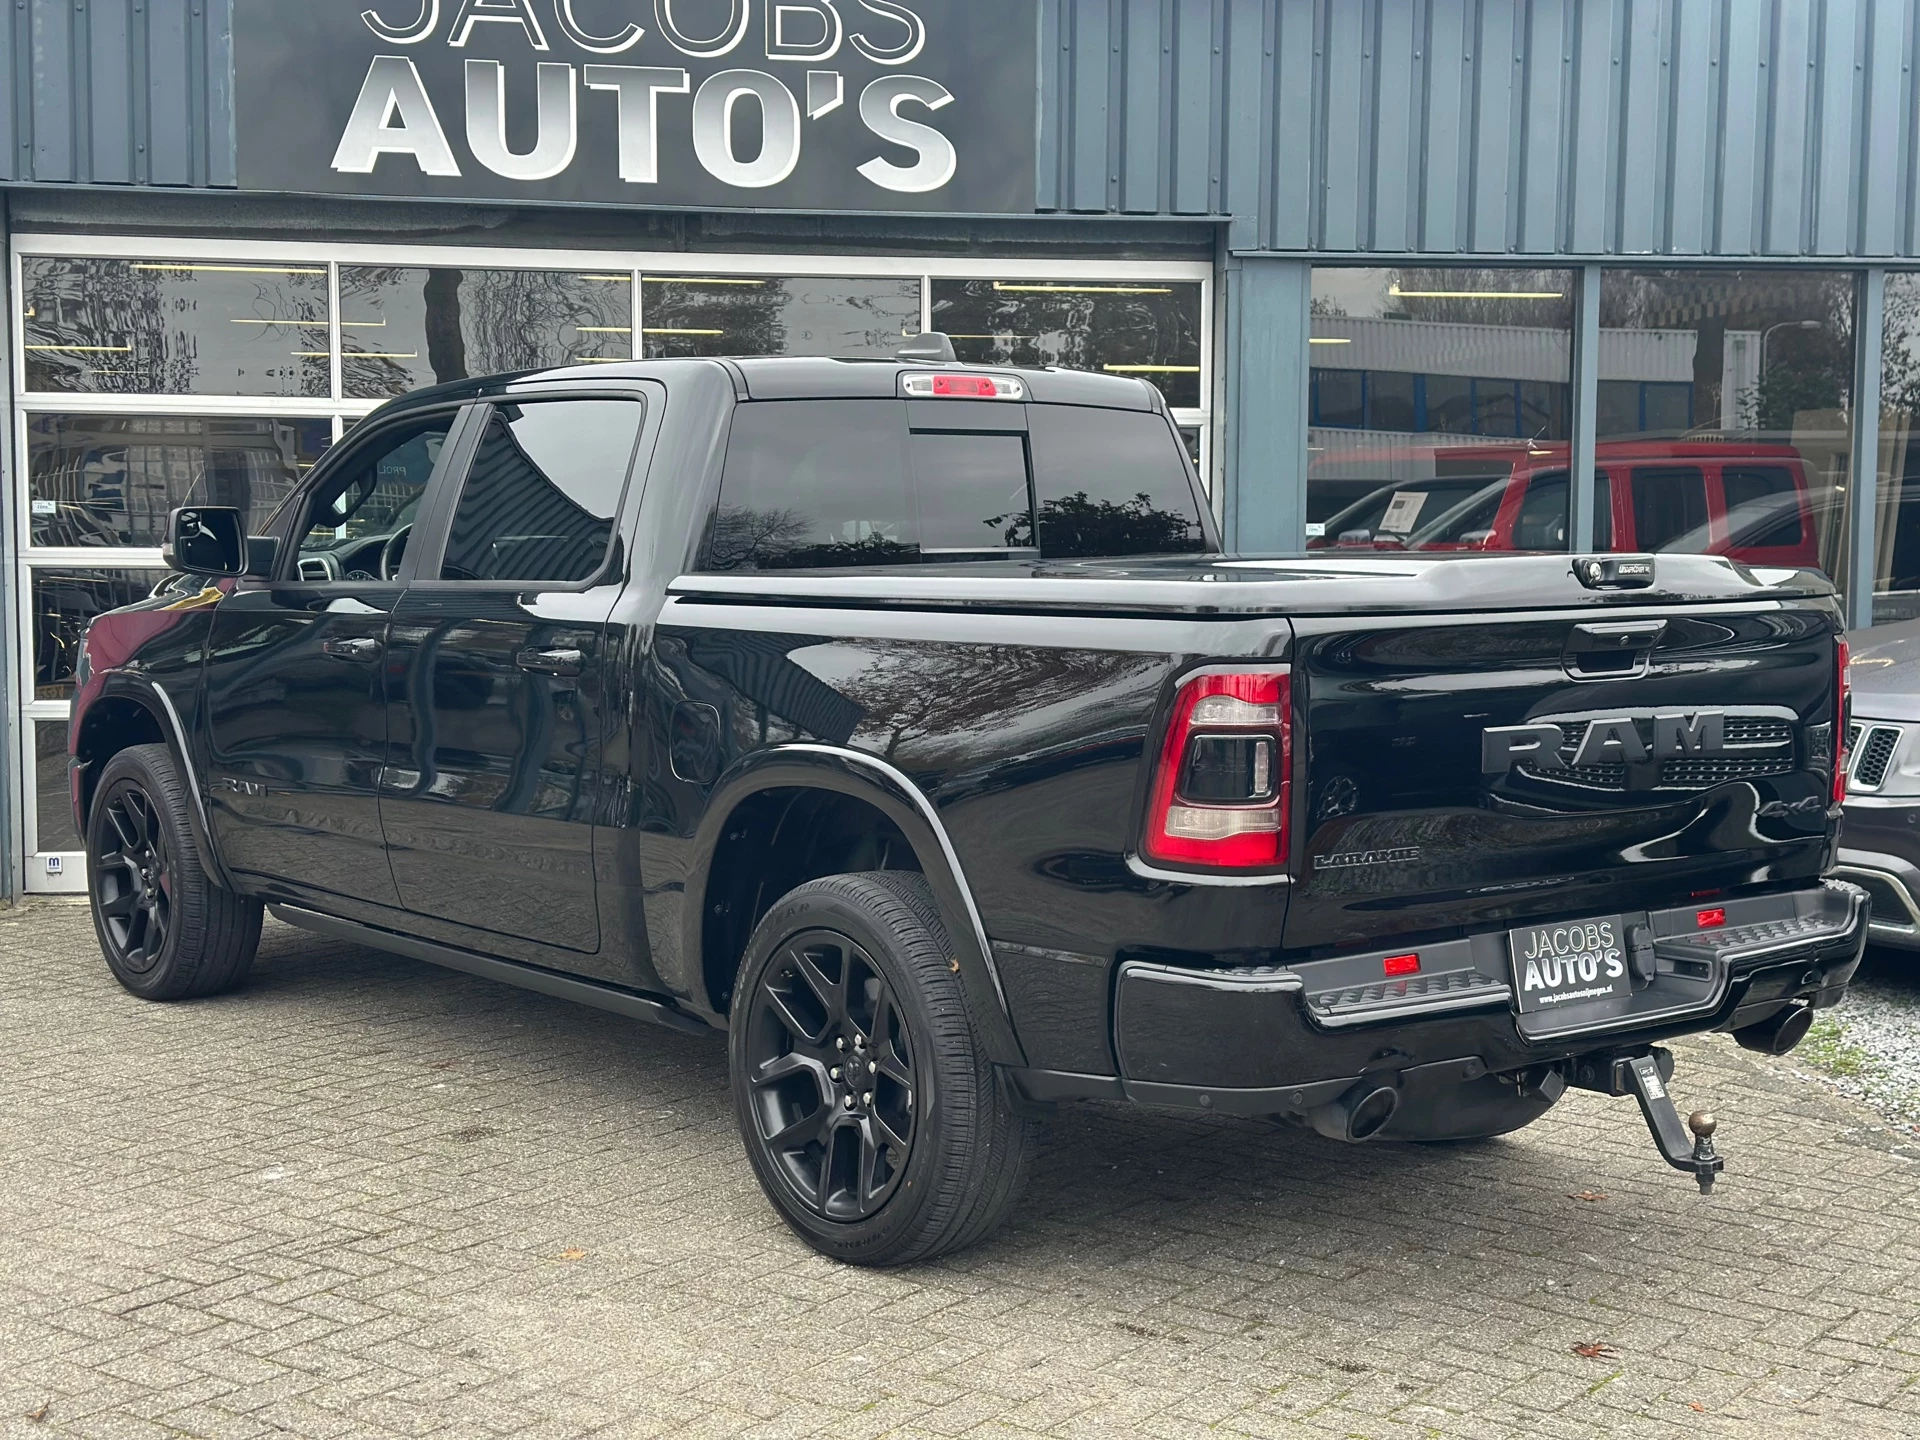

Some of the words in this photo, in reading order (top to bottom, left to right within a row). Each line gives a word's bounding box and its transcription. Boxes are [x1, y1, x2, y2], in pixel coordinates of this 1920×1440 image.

[330, 55, 957, 192] AUTO'S
[1482, 709, 1724, 774] RAM
[221, 777, 268, 797] RAM
[1314, 846, 1420, 869] LARAMIE
[1524, 922, 1614, 959] JACOBS
[1524, 948, 1623, 991] AUTO'S
